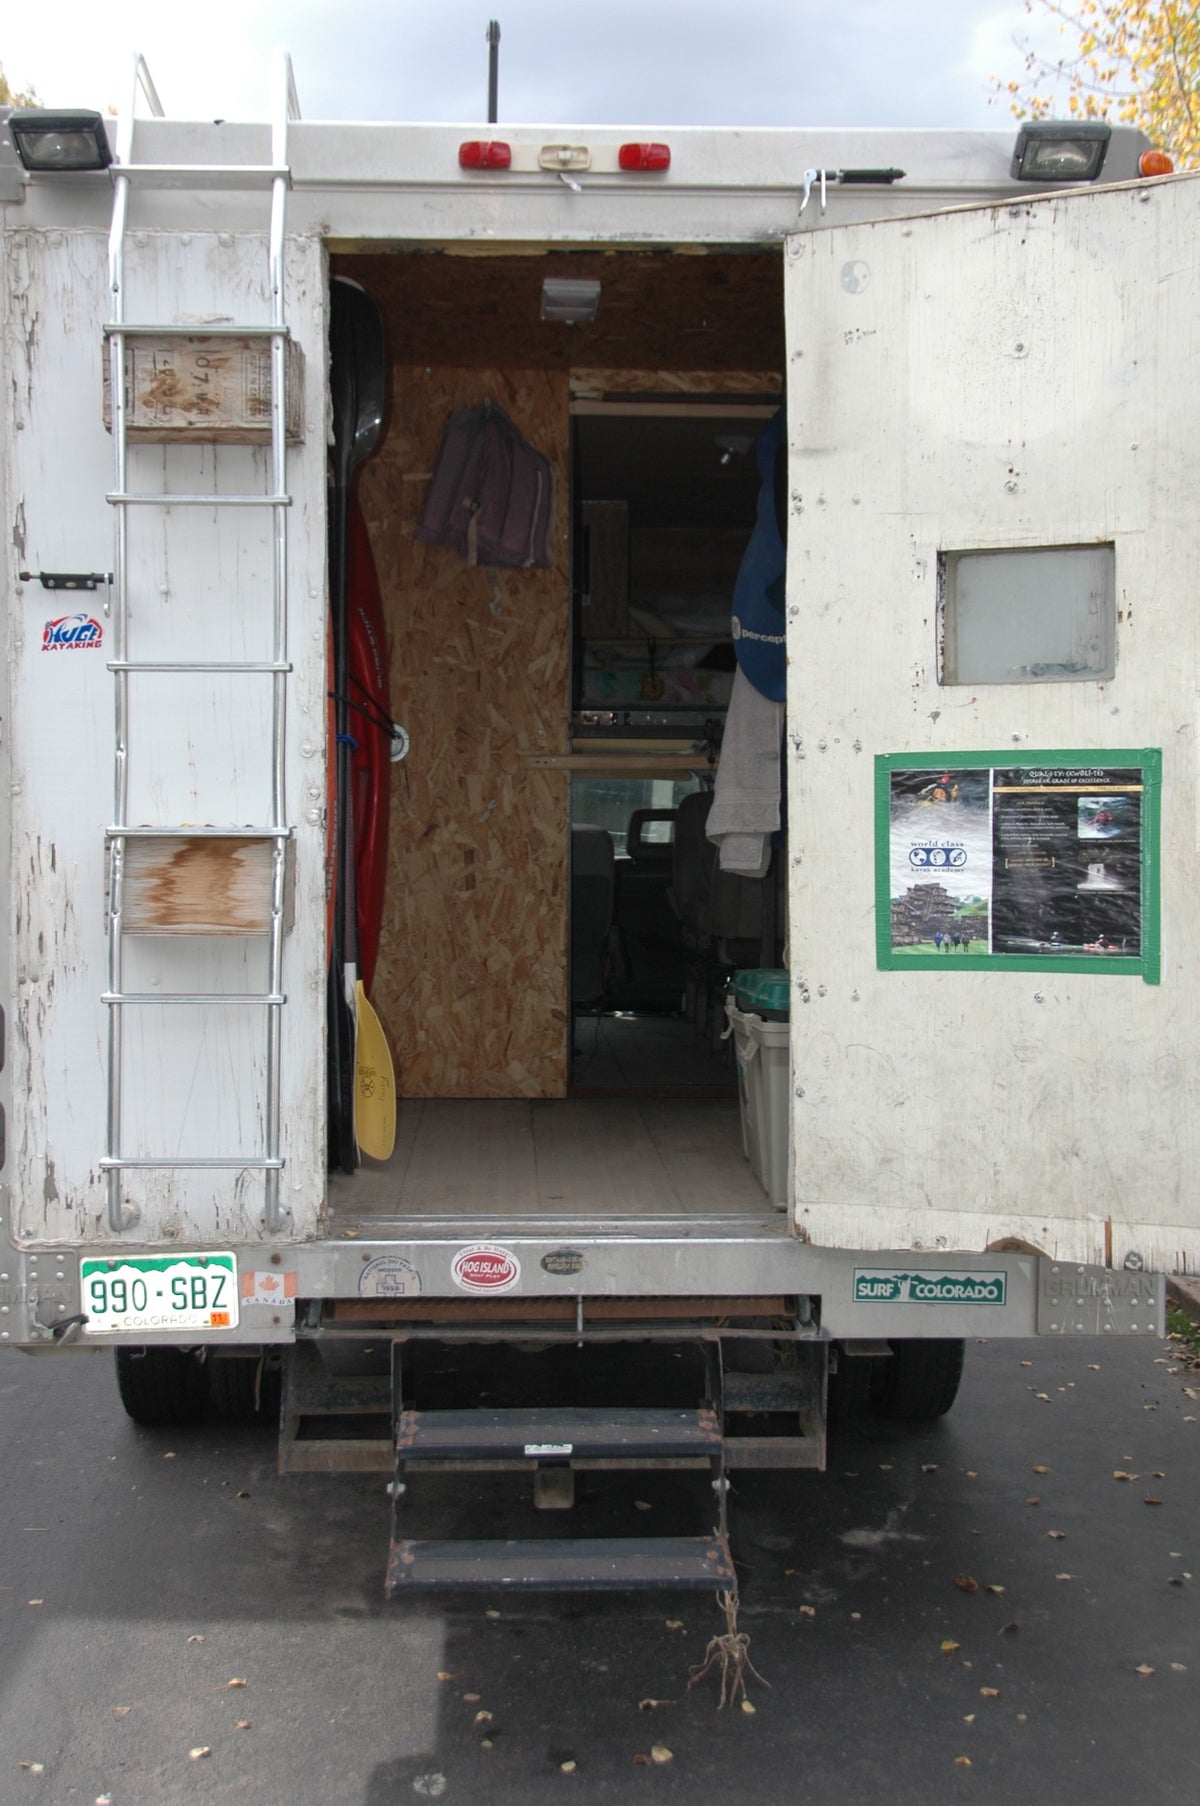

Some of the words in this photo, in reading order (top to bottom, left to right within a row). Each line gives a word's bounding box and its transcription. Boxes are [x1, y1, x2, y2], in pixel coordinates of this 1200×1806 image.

[47, 621, 99, 643] HUGE
[42, 640, 102, 651] KAYAKING
[462, 1260, 480, 1273] HOG
[480, 1261, 510, 1274] ISLAND
[857, 1282, 894, 1297] SURF
[915, 1283, 999, 1299] COLORADO
[246, 1296, 293, 1305] CANADA
[123, 1313, 199, 1327] COLORADO
[211, 1313, 224, 1323] 11
